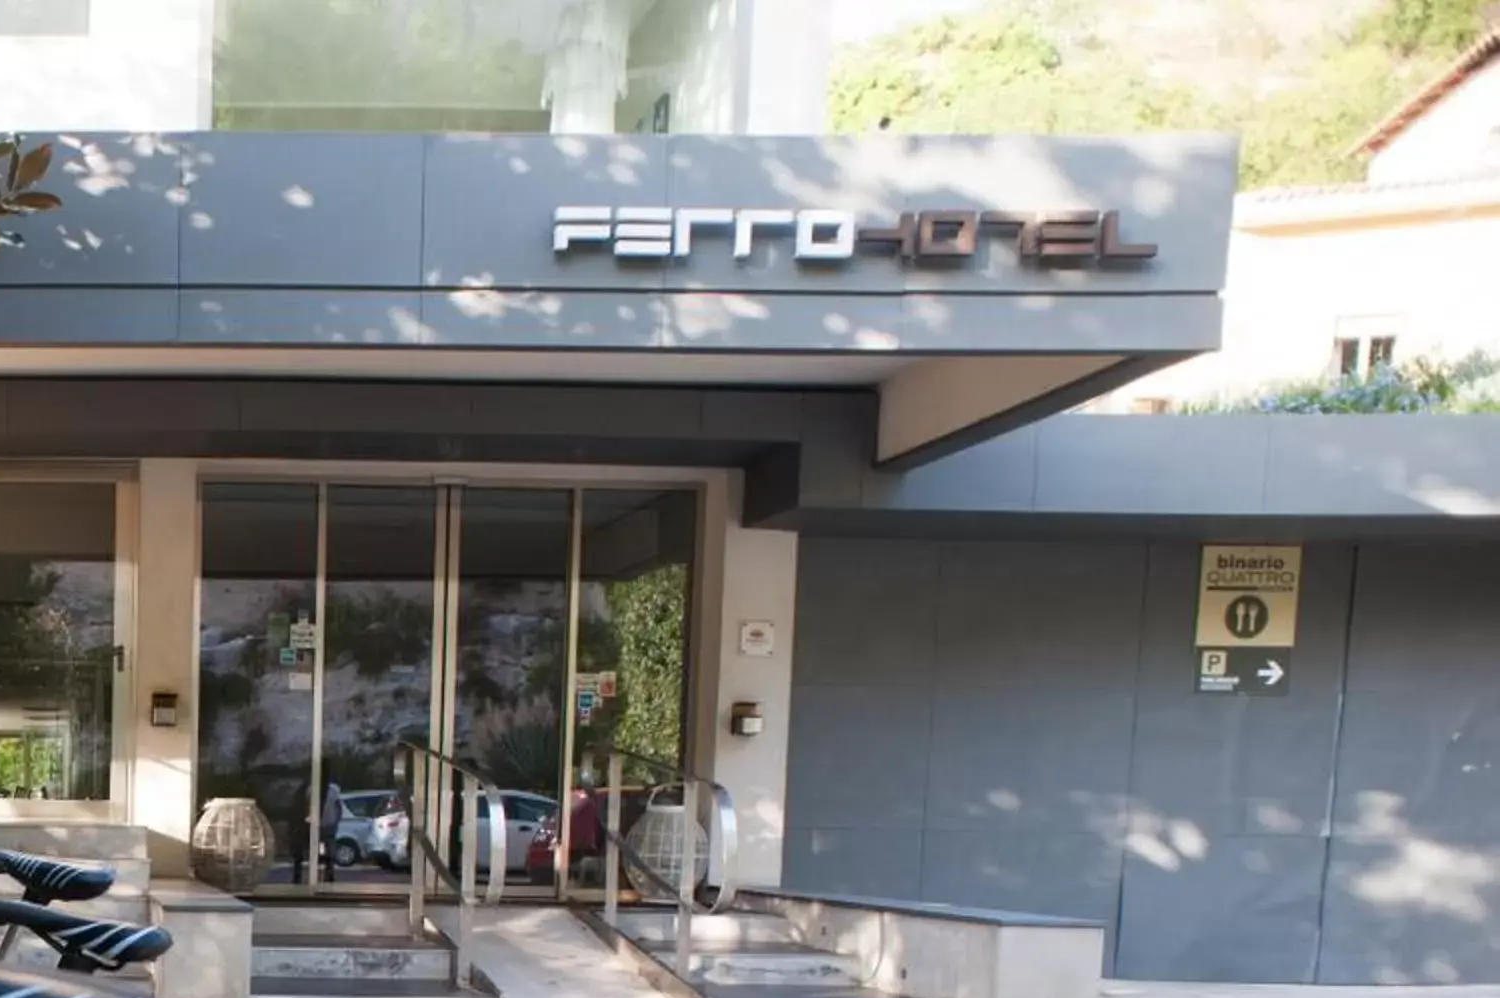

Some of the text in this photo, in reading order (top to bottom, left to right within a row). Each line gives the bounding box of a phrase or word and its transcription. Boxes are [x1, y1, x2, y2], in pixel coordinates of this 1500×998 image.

[1217, 554, 1284, 570] binario
[1206, 571, 1296, 585] QUATTRO
[1208, 654, 1221, 672] P
